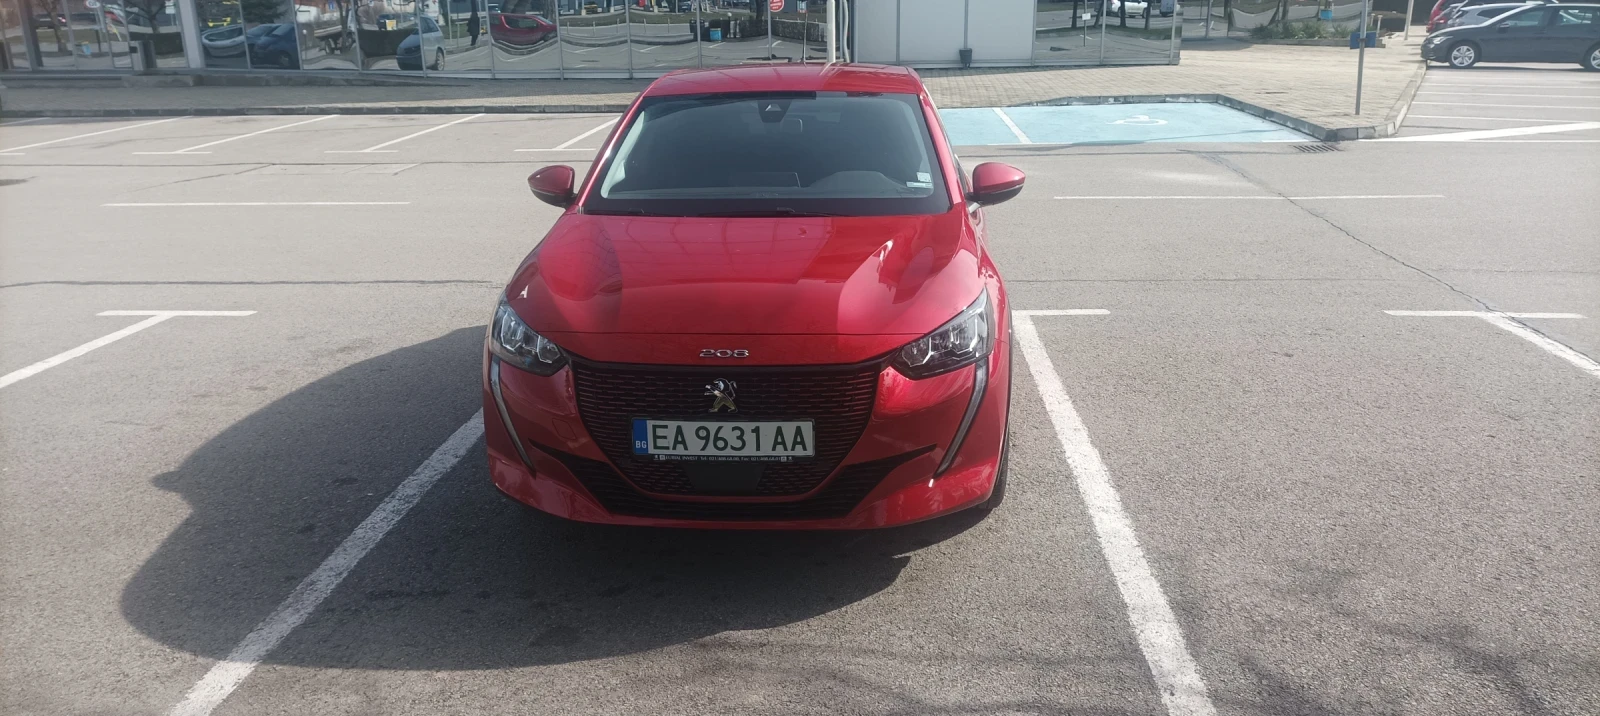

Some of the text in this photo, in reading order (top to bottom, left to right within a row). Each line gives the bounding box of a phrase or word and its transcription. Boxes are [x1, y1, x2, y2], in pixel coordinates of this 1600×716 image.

[699, 348, 749, 358] 208
[652, 424, 808, 452] EA 9631 AA
[635, 440, 647, 449] BG
